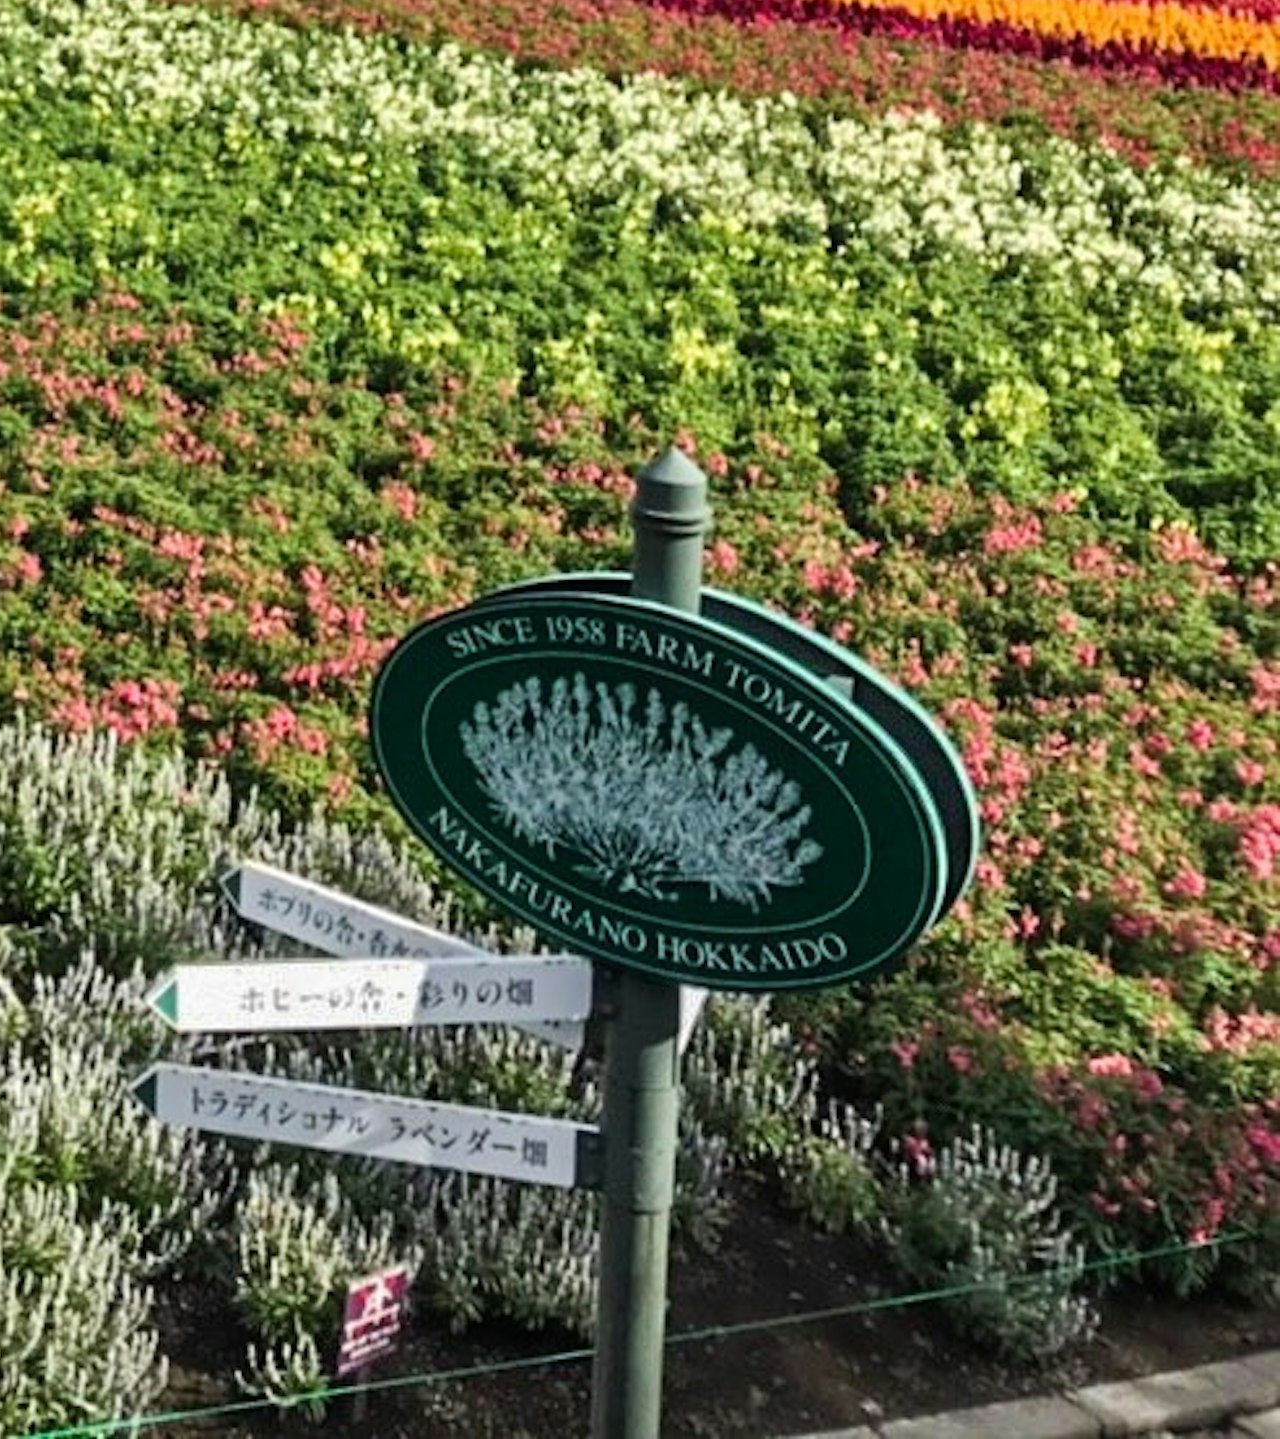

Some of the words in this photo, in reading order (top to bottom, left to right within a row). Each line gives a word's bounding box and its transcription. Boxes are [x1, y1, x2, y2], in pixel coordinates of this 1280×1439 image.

[445, 617, 537, 658] SINCE
[546, 615, 606, 645] 1958
[615, 622, 714, 677] FARM
[724, 659, 849, 766] TOMITA
[429, 806, 646, 953] NAKAFURANO
[656, 931, 848, 972] HOKKAIDO
[191, 1086, 370, 1136] トラディショナル
[389, 1116, 548, 1169] ラベンダー畑
